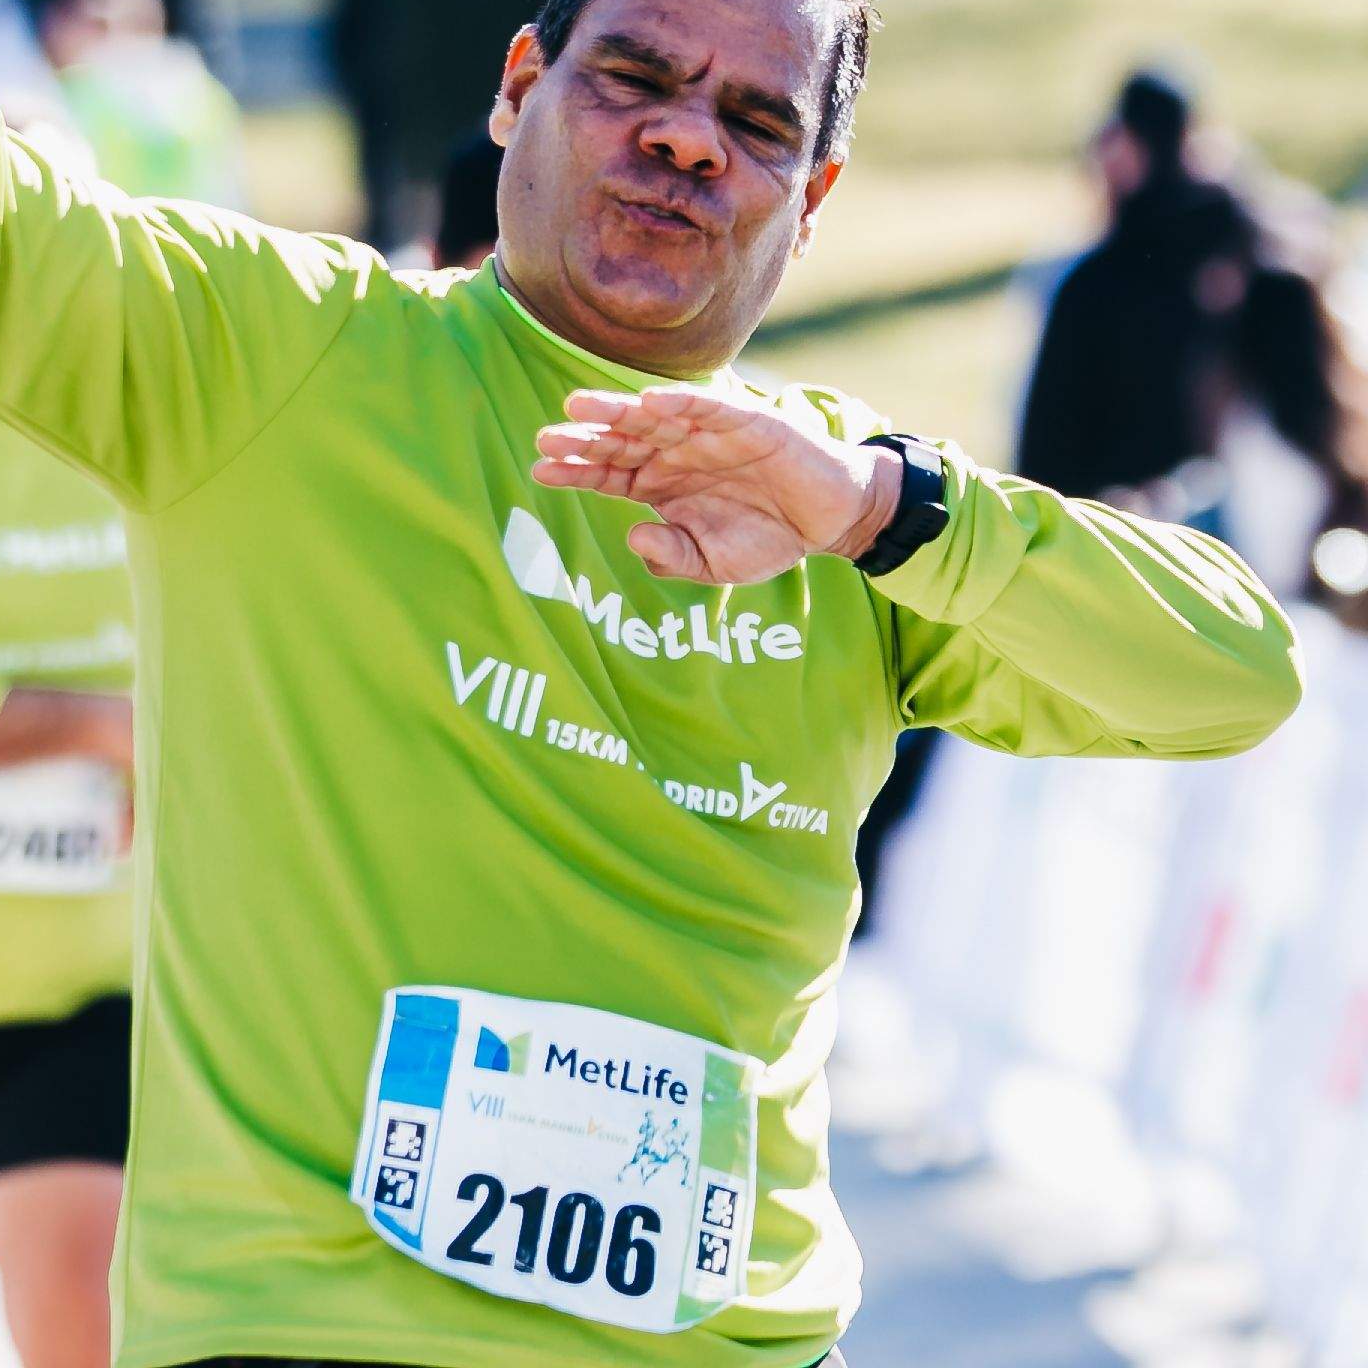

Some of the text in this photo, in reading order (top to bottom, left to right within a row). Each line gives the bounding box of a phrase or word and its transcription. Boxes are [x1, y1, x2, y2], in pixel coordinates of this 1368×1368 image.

[578, 575, 803, 664] MetLife
[447, 641, 546, 738] VIII
[546, 719, 628, 766] 15KM
[545, 1043, 688, 1105] MetLife
[445, 1173, 662, 1298] 2106
